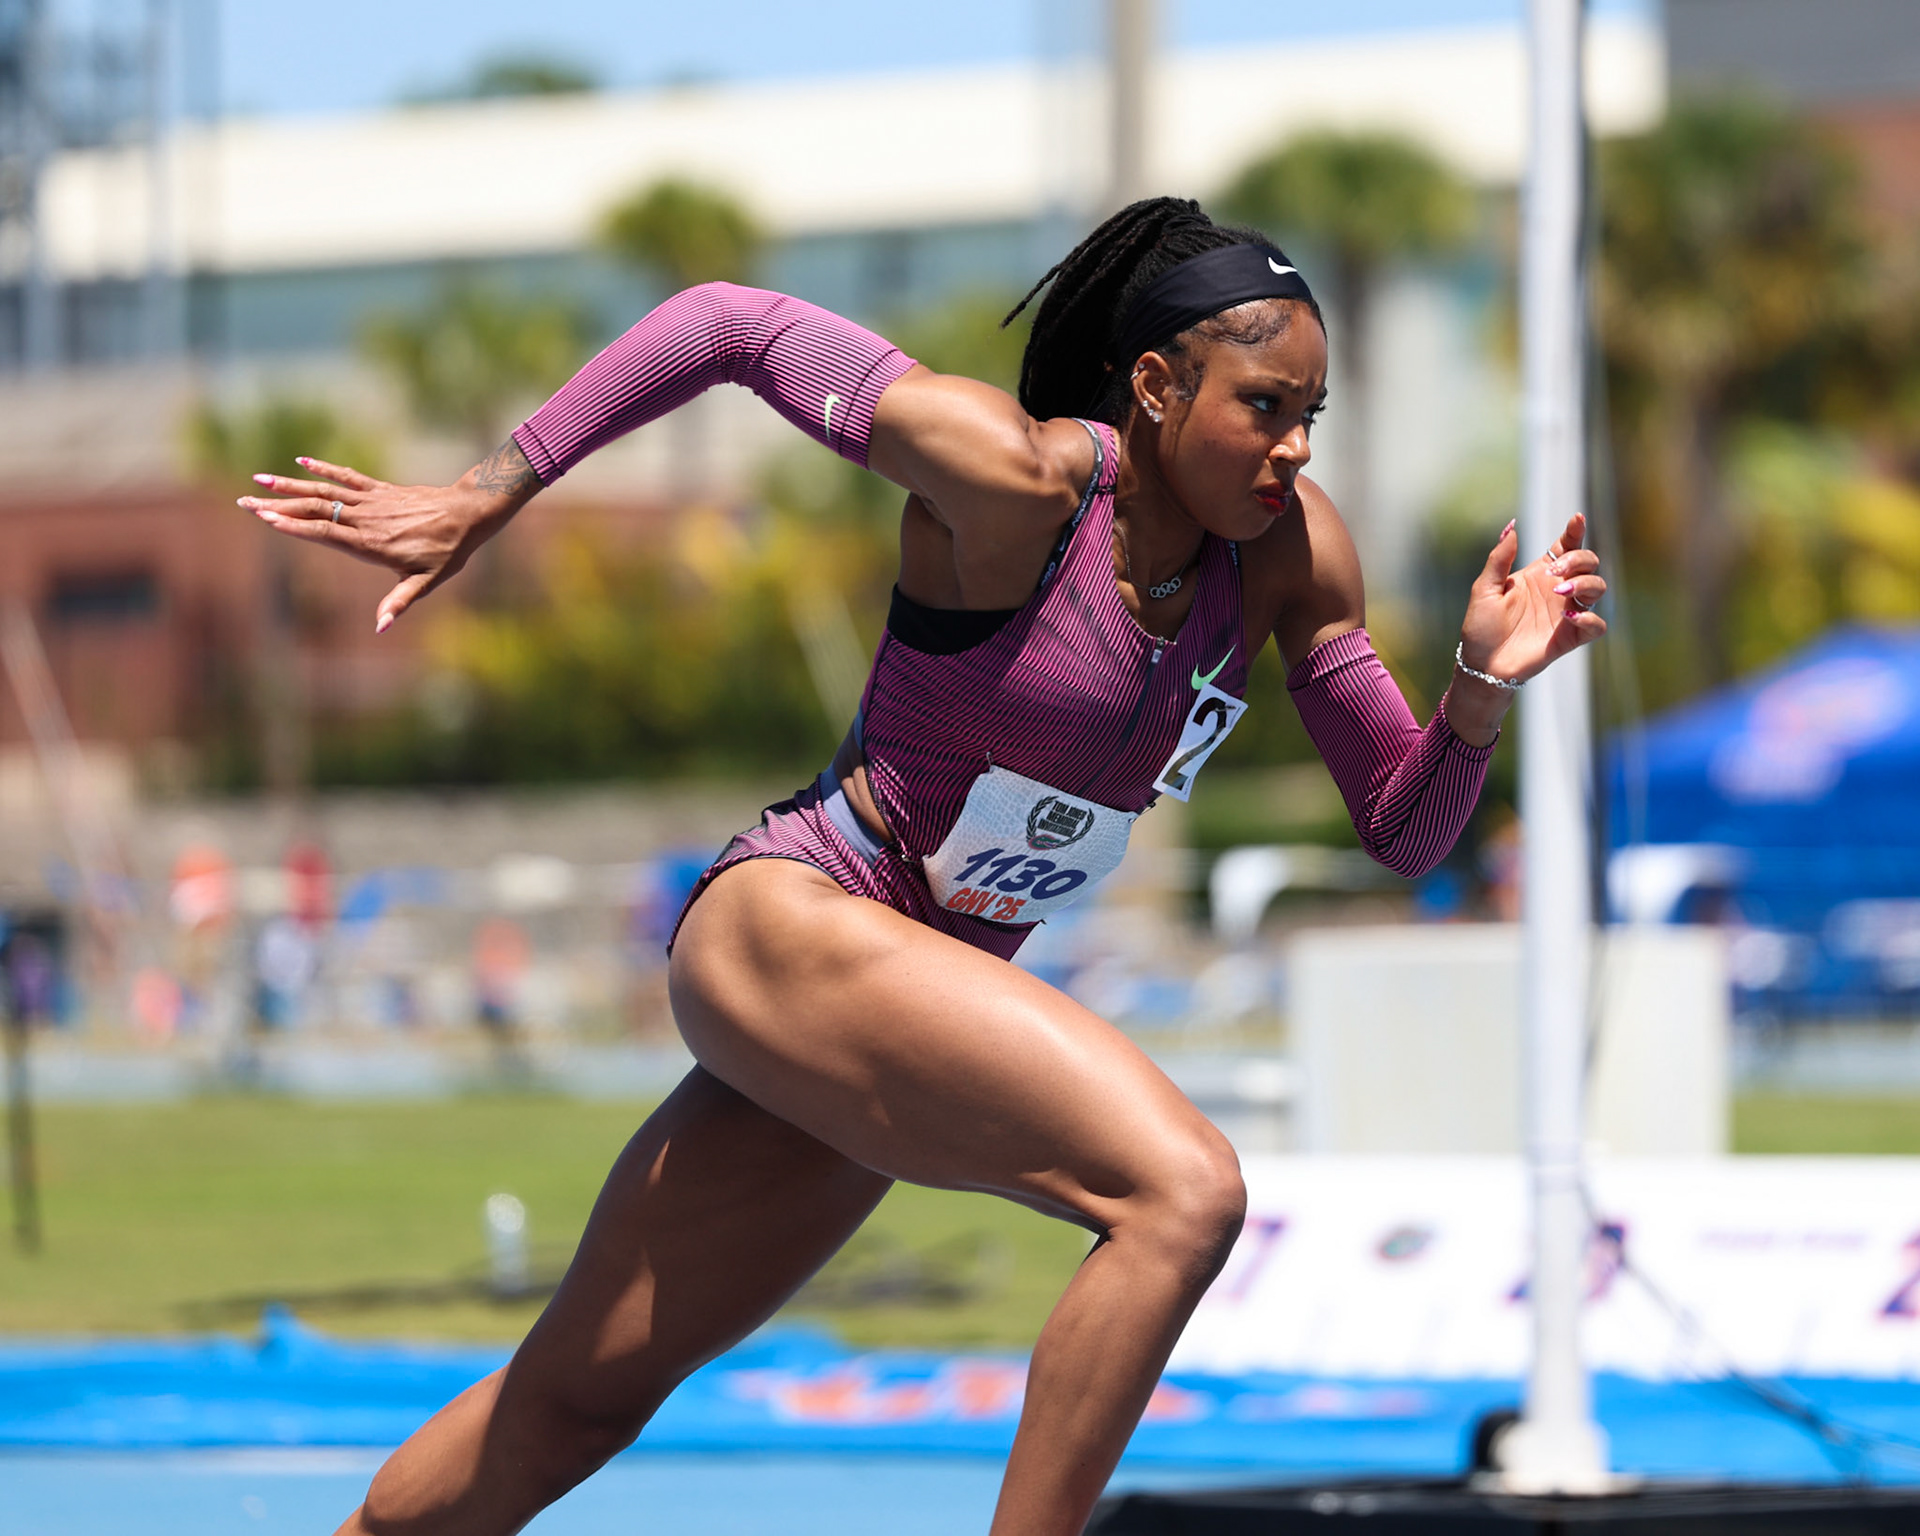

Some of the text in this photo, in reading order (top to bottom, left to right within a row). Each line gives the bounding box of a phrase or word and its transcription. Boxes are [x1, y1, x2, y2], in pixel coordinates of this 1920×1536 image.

[1161, 697, 1227, 791] 2
[954, 848, 1087, 900] 1130
[946, 888, 999, 916] GNV
